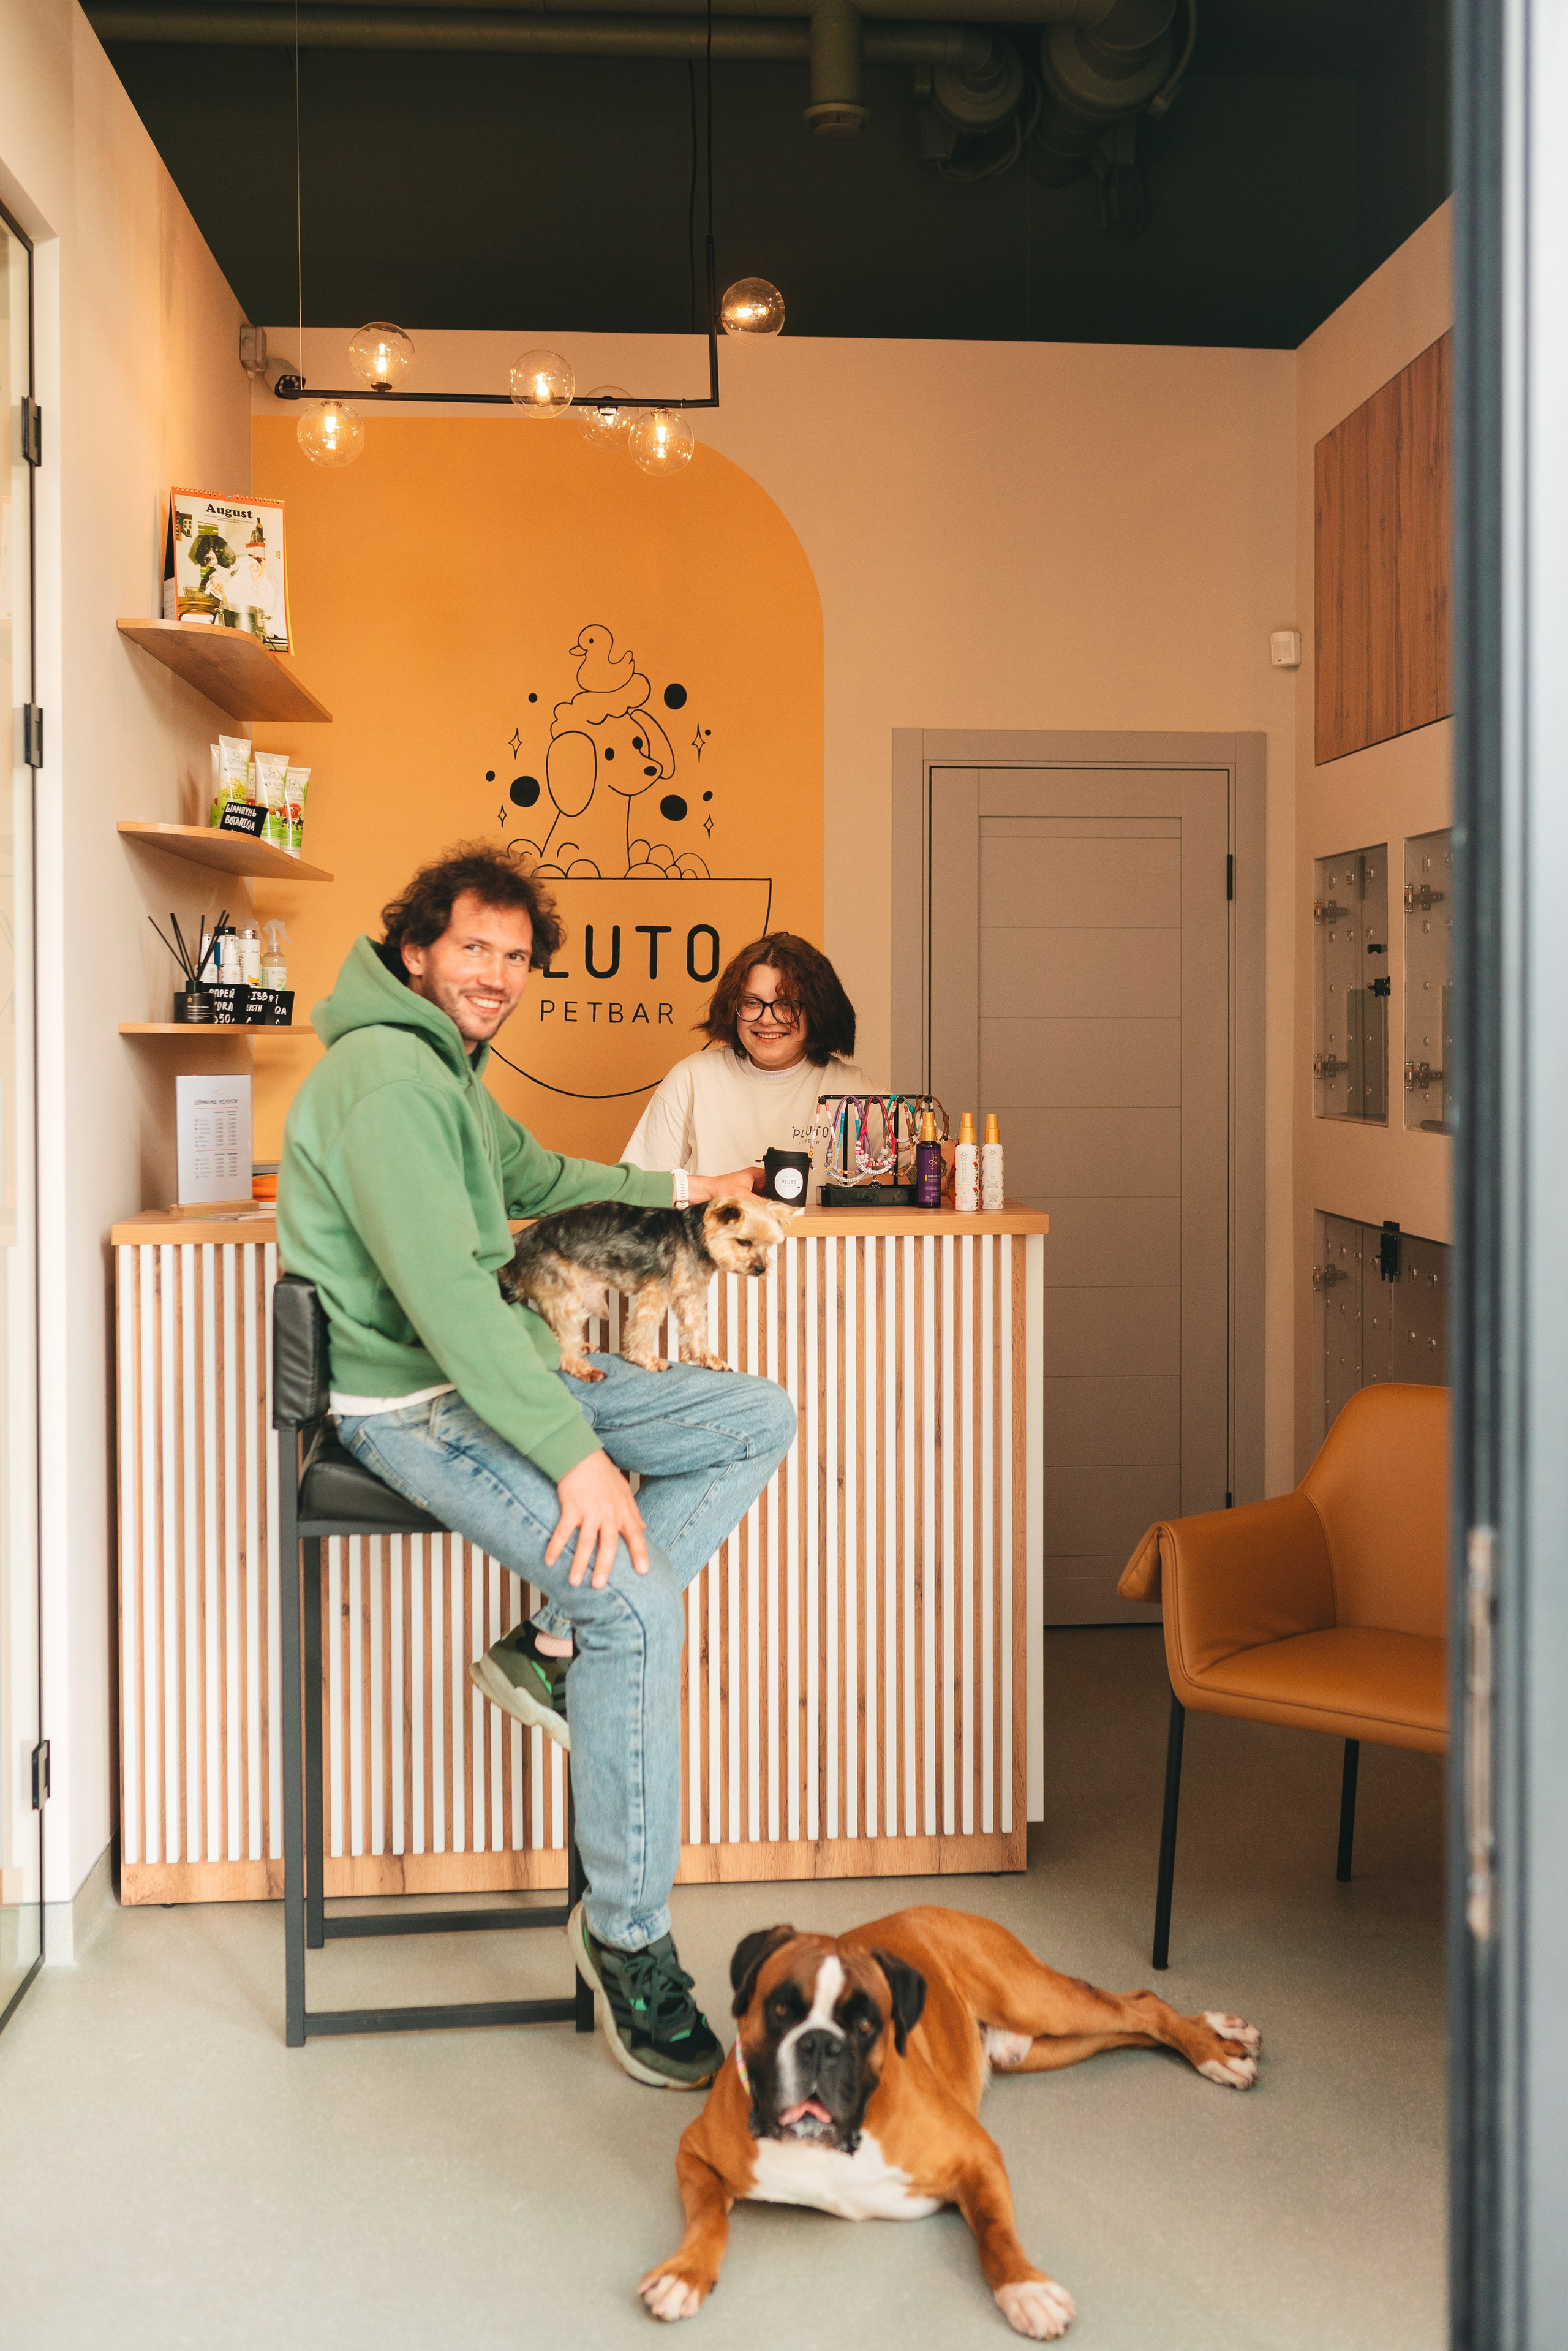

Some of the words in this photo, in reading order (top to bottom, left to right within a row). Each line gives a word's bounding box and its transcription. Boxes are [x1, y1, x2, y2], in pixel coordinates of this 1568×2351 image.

[206, 504, 253, 519] August
[225, 803, 257, 817] ШАМПУНЬ
[224, 814, 255, 831] BOTANIQA
[543, 923, 720, 983] LUTO
[540, 1000, 674, 1024] PETBAR
[793, 1125, 829, 1139] PLUTO
